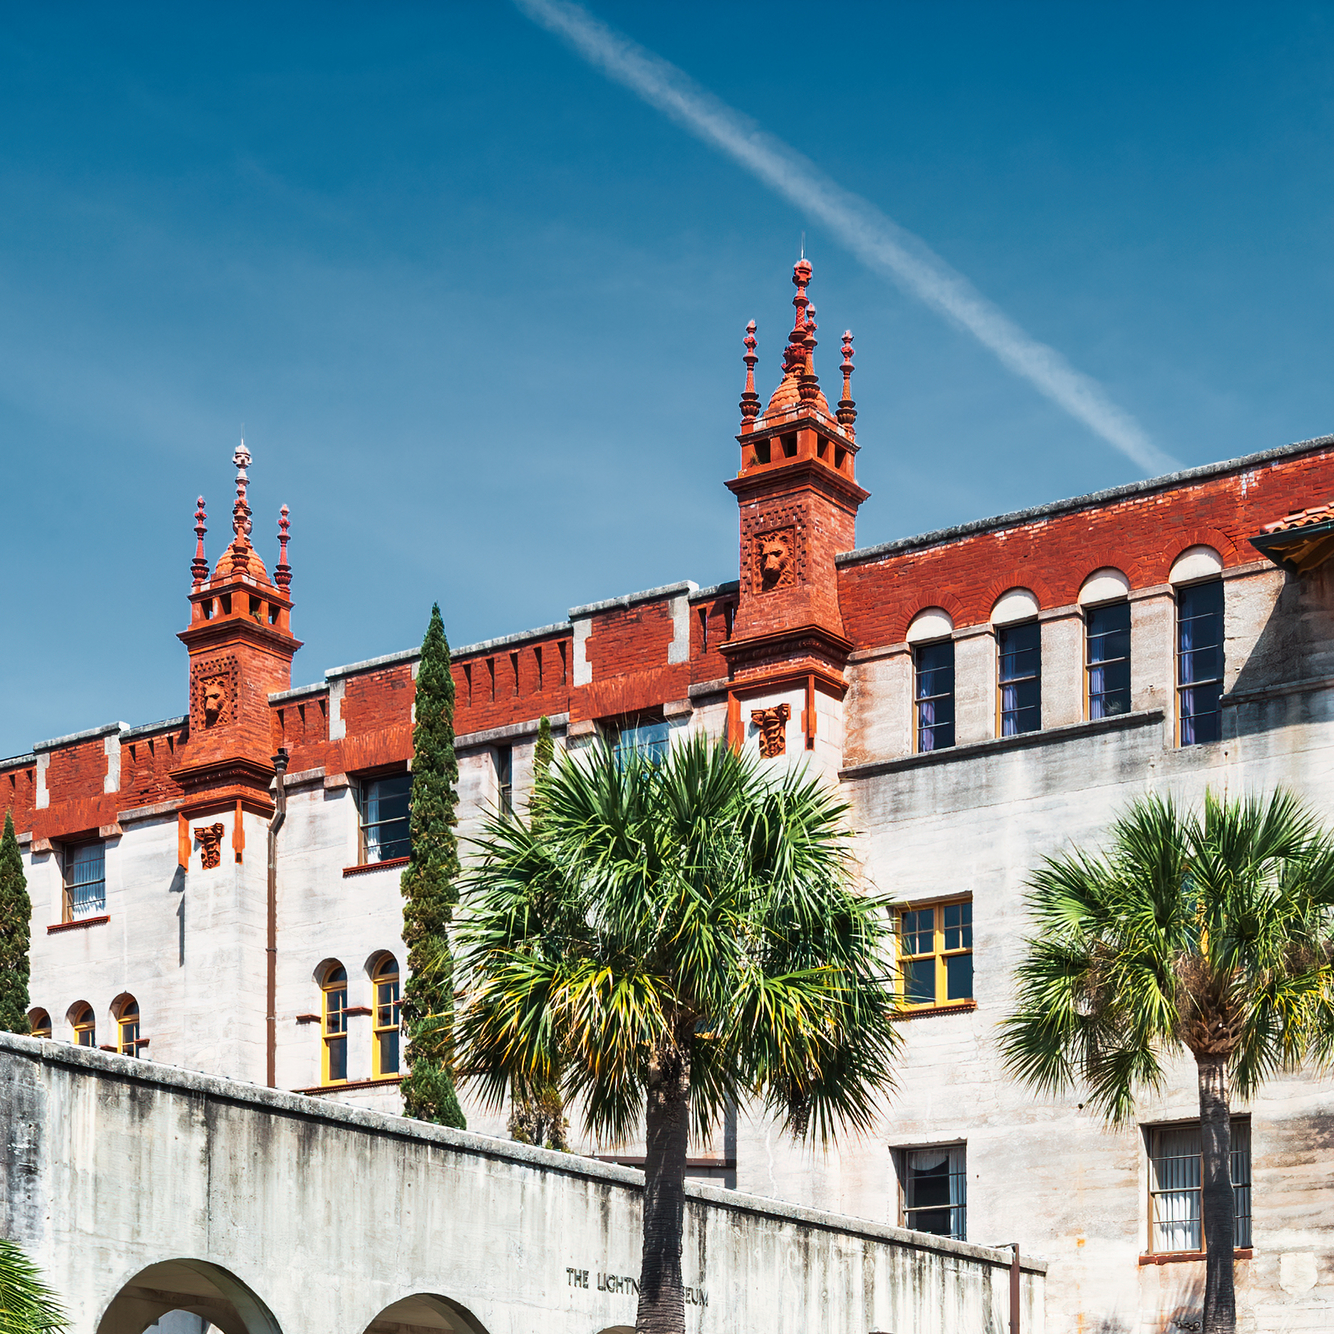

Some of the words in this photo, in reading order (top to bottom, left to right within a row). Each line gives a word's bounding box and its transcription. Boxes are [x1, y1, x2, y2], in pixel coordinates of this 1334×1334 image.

[566, 1267, 589, 1289] THE
[597, 1272, 640, 1296] LIGHTN
[683, 1286, 709, 1307] EUM
